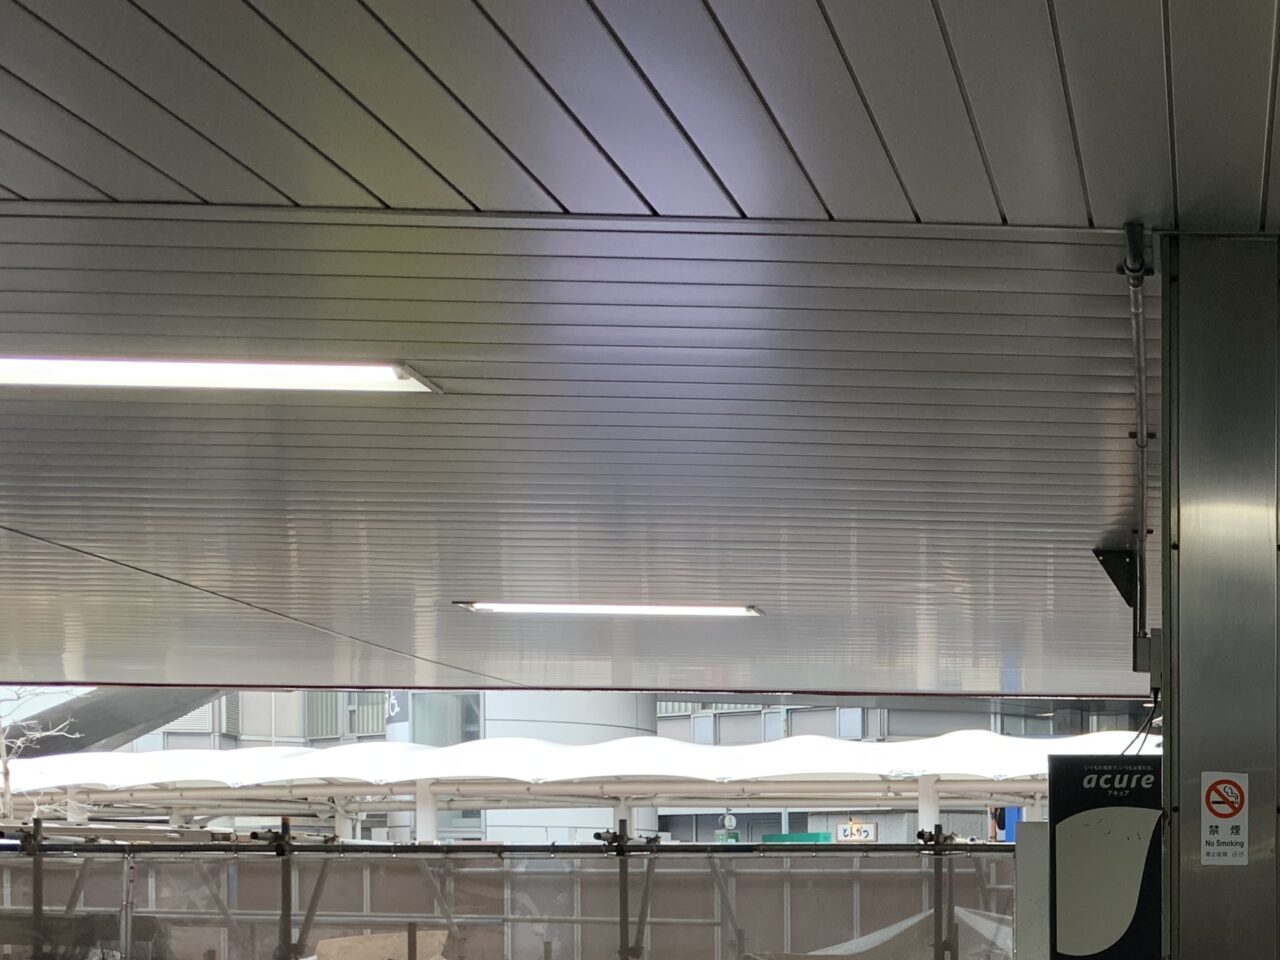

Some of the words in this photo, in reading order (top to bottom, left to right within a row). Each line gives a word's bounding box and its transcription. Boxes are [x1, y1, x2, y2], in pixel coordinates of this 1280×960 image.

[1082, 774, 1155, 789] acure
[842, 826, 870, 839] とんかつ
[1208, 824, 1241, 836] 禁煙
[1215, 840, 1245, 849] Smoking
